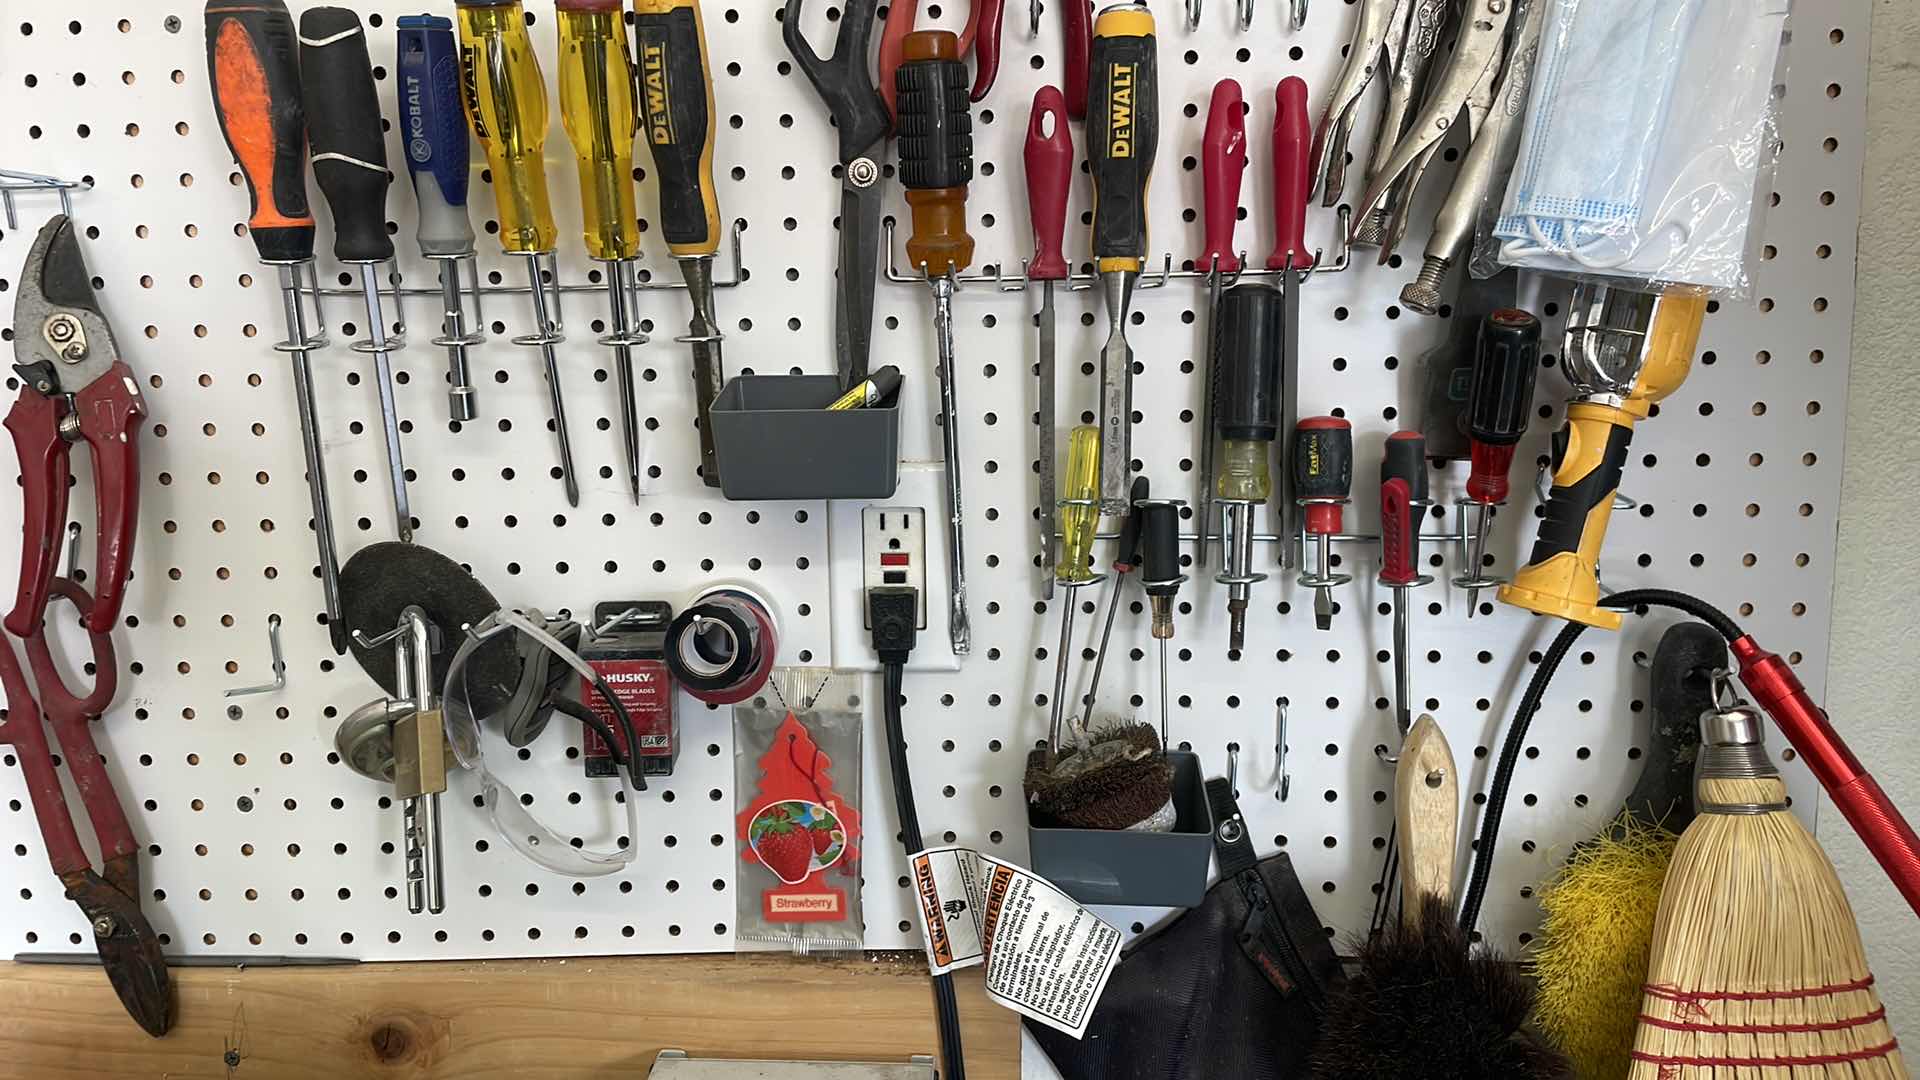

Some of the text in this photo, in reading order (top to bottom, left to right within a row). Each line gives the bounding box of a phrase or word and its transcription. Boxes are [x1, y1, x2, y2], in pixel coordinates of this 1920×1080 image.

[406, 76, 424, 138] KOBALT
[461, 47, 488, 138] DEWALT
[644, 46, 670, 144] DEWALT
[1111, 63, 1132, 158] DEWALT
[606, 673, 650, 683] HUSKY
[775, 895, 833, 910] Strawberry
[919, 863, 946, 943] WARNING
[1004, 878, 1022, 911] Eléctrico
[1016, 899, 1024, 908] de
[1020, 878, 1033, 899] pared
[1024, 902, 1032, 912] de
[996, 912, 1009, 941] Choque
[1005, 909, 1020, 940] contacto
[1014, 913, 1027, 934] tierra
[994, 943, 1000, 953] de
[1002, 941, 1009, 951] un
[1002, 943, 1016, 980] conexión
[1014, 911, 1049, 999] No quite el terminal de
[1030, 924, 1065, 1006] No use un adaptador.
[1037, 997, 1046, 1009] No
[1042, 980, 1052, 995] use
[1048, 968, 1056, 979] un
[1053, 946, 1065, 967] cable
[1063, 915, 1080, 945] eléctrico
[992, 959, 1004, 989] Conecte
[999, 981, 1006, 992] de
[1005, 951, 1022, 995] terminales.
[1023, 964, 1036, 1002] conexión
[1035, 935, 1049, 956] tierra.
[1052, 1004, 1062, 1016] No
[1058, 979, 1072, 1003] seguir
[1069, 959, 1082, 978] estas
[1061, 994, 1076, 1020] puede
[1073, 956, 1093, 993] ocasionar
[1088, 948, 1097, 956] la
[1045, 972, 1065, 1012] extensión.
[1068, 989, 1089, 1023] incendio
[1089, 954, 1105, 981] choque
